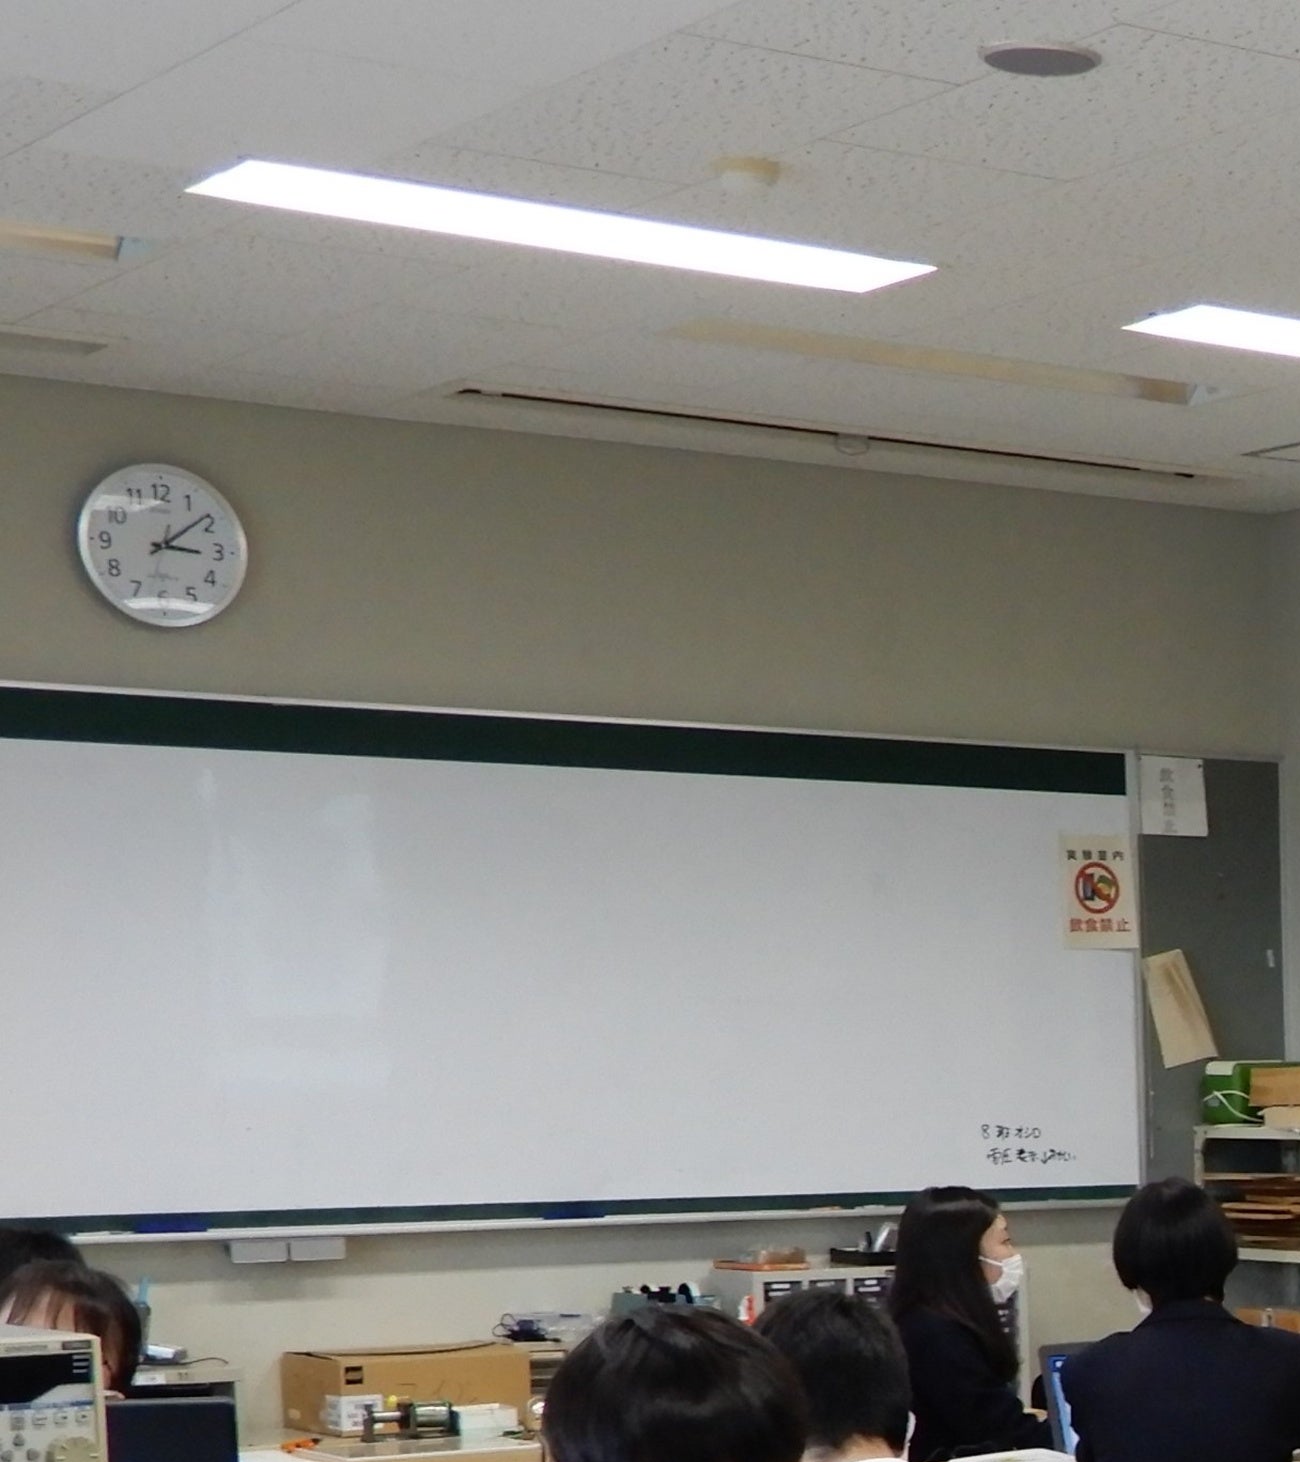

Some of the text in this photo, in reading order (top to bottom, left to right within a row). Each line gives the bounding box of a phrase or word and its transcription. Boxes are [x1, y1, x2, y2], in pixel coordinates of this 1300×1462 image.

[126, 488, 142, 505] 11
[152, 484, 171, 503] 12
[184, 495, 192, 511] 1
[108, 506, 127, 524] 10
[204, 514, 215, 533] 2
[99, 531, 112, 549] 9
[212, 543, 224, 561] 3
[108, 559, 121, 577] 8
[203, 570, 216, 586] 4
[131, 580, 142, 597] 7
[186, 587, 197, 602] 5
[1070, 918, 1131, 933] 飲食禁止
